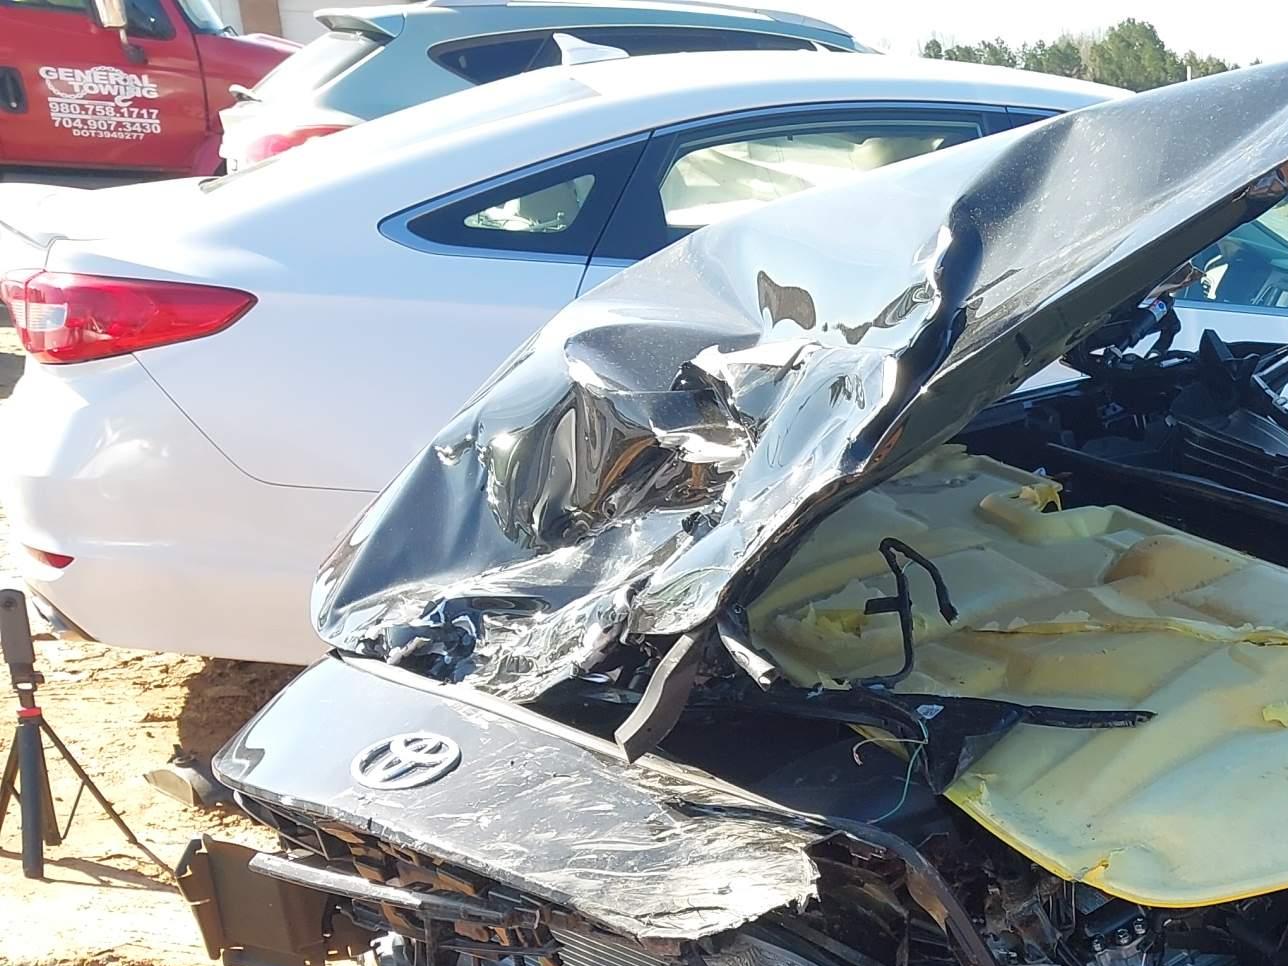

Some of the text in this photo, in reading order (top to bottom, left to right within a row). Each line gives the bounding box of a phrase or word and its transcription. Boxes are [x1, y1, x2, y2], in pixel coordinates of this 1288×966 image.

[39, 66, 157, 87] GENERAL
[49, 103, 159, 119] 980.758.1717
[54, 118, 161, 133] 704.907.3430
